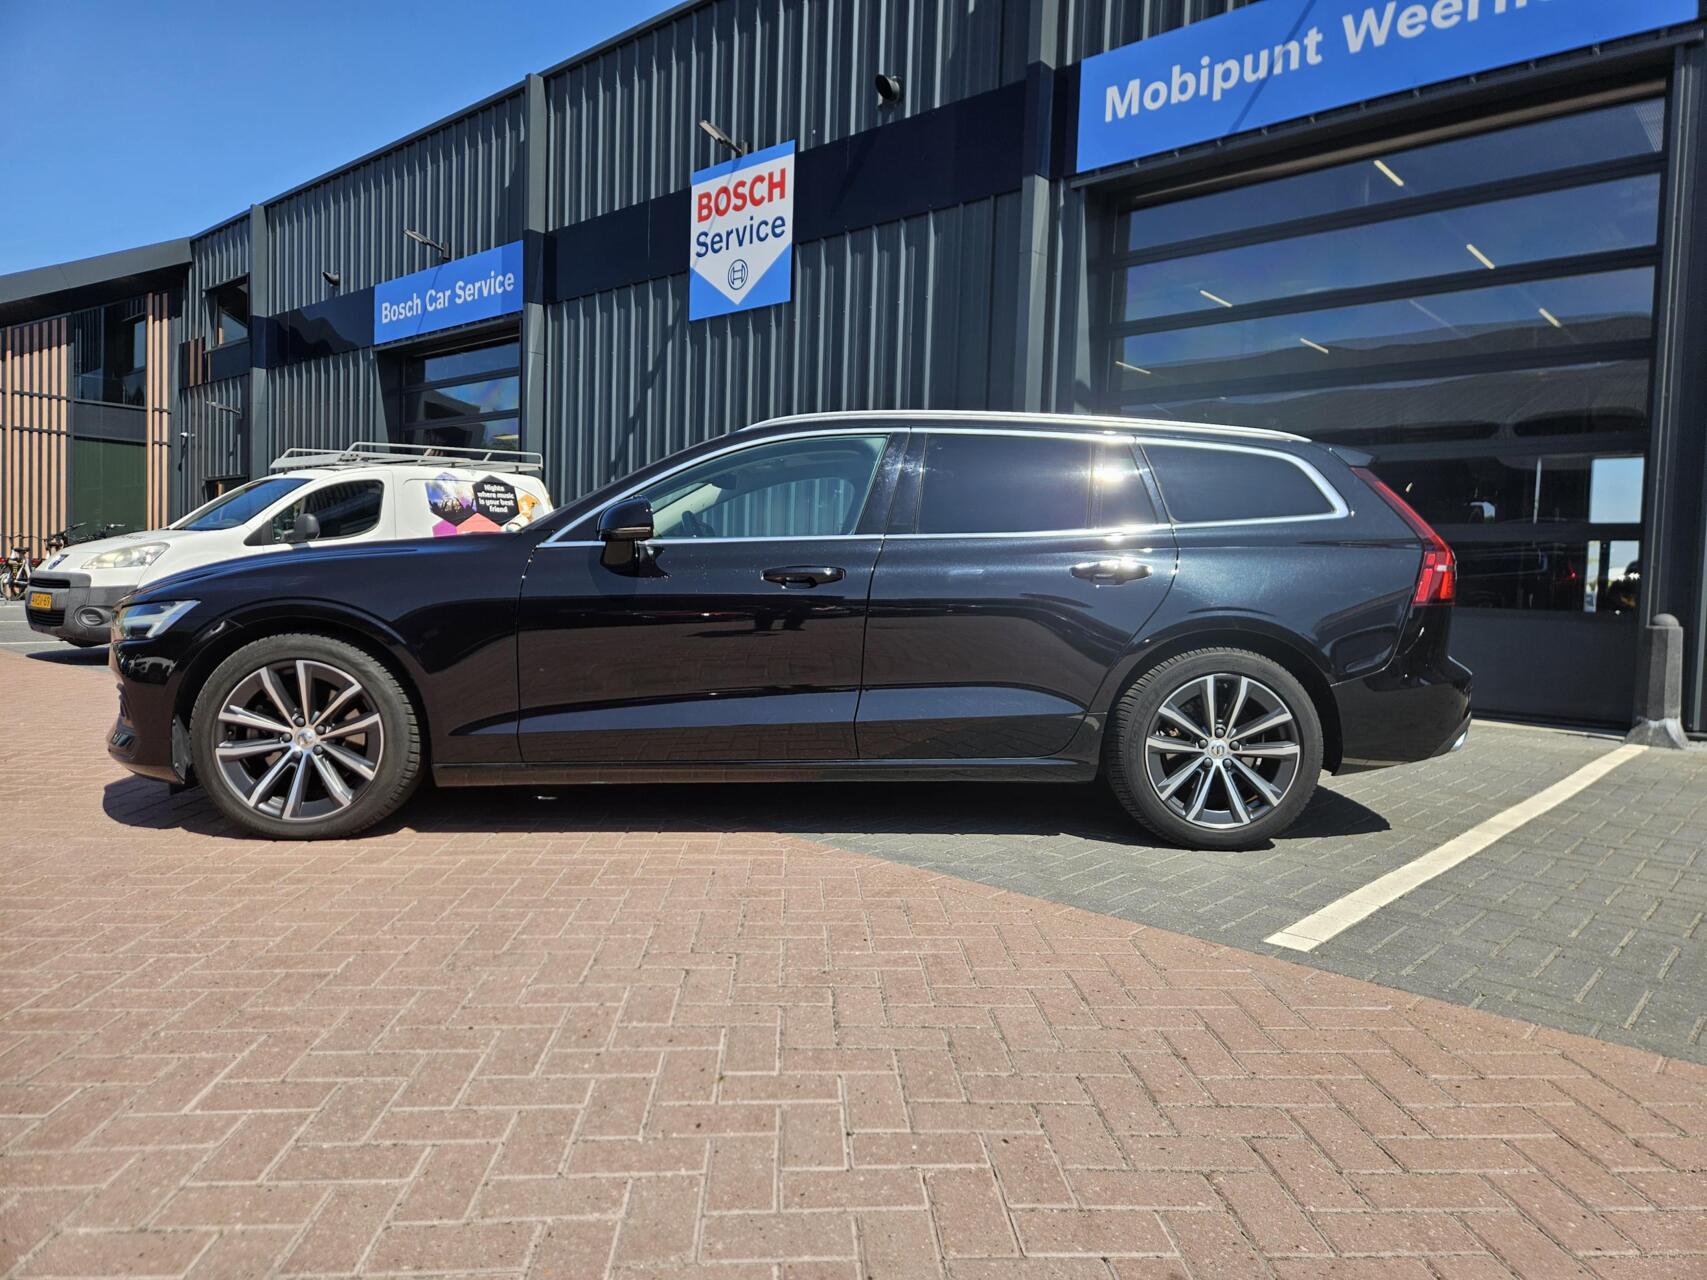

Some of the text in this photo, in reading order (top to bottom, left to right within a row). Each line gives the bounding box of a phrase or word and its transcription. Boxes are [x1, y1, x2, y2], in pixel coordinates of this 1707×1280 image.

[1103, 25, 1324, 123] Mobipunt
[696, 167, 786, 223] BOSCH
[695, 215, 786, 258] Service
[381, 270, 515, 324] Bosch Car Service
[477, 491, 497, 499] where
[483, 483, 505, 492] Nights
[489, 505, 509, 513] friend
[500, 498, 515, 506] best
